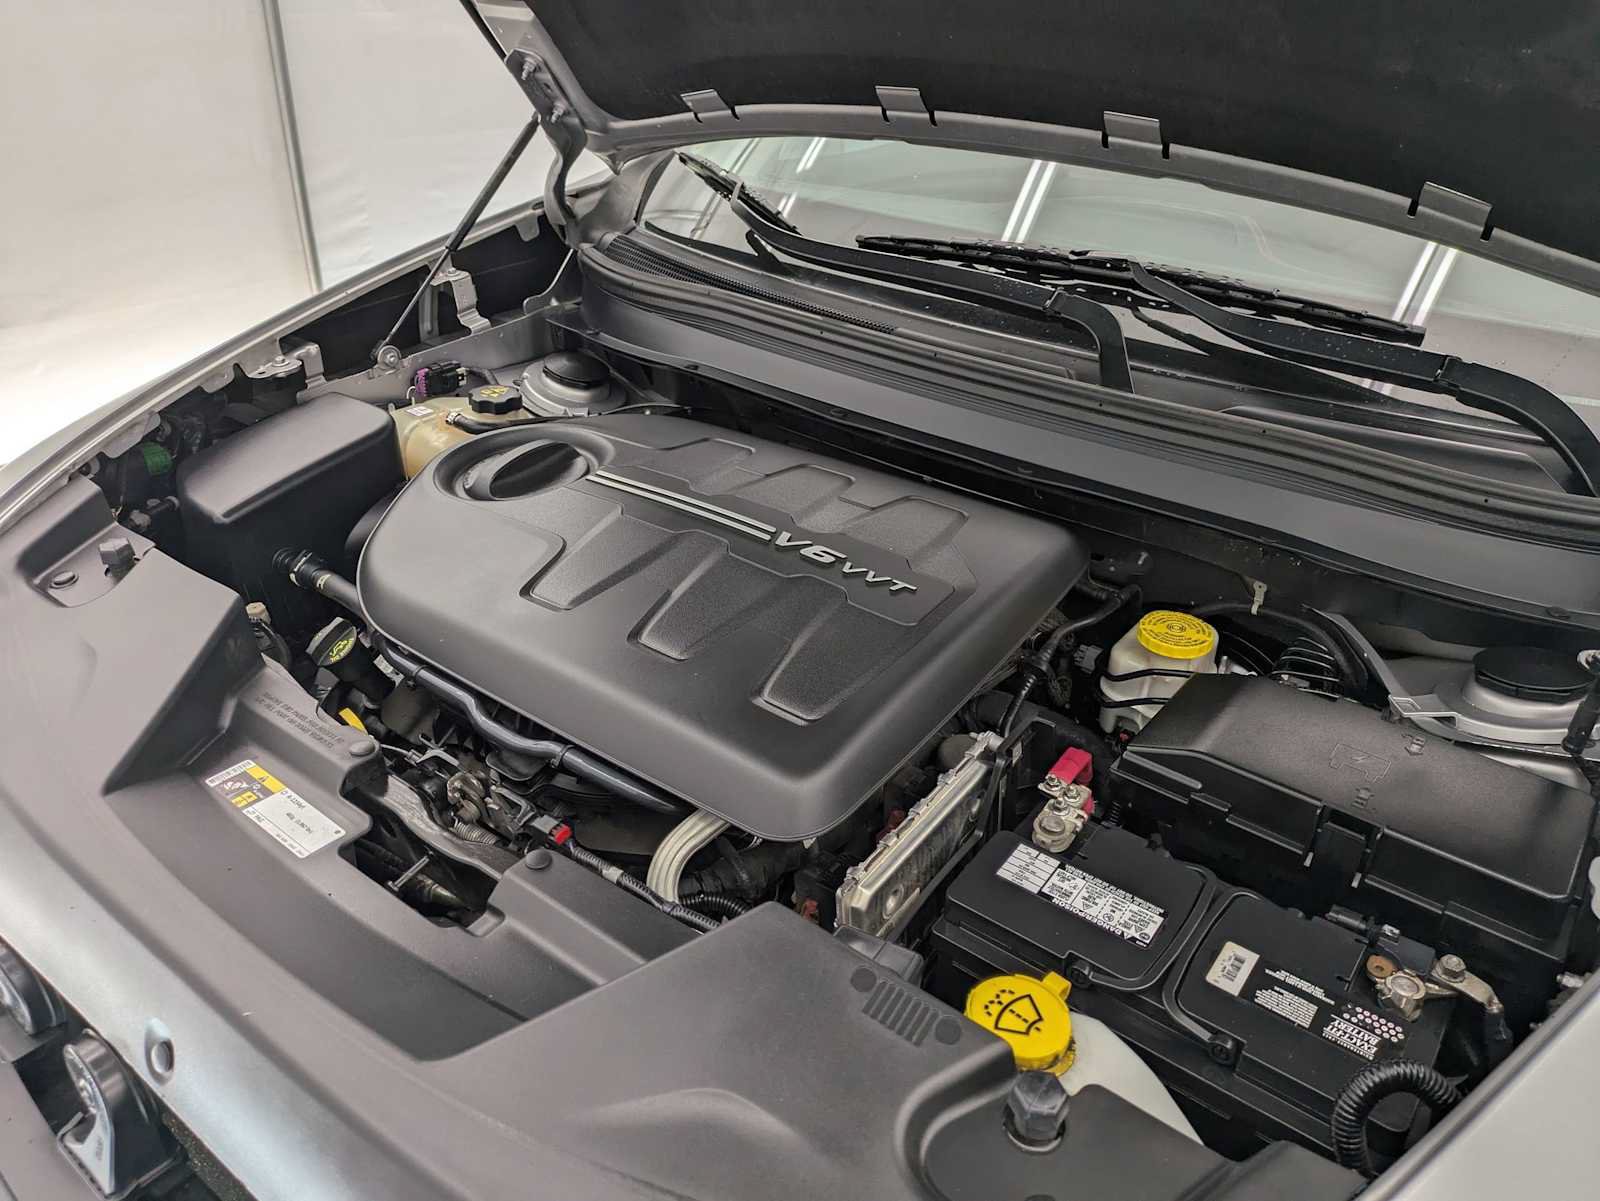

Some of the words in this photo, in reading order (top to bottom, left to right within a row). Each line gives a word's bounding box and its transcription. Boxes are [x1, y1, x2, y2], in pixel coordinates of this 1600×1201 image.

[775, 531, 847, 564] V6
[842, 561, 917, 591] VVT
[1331, 1019, 1378, 1045] BATTERY
